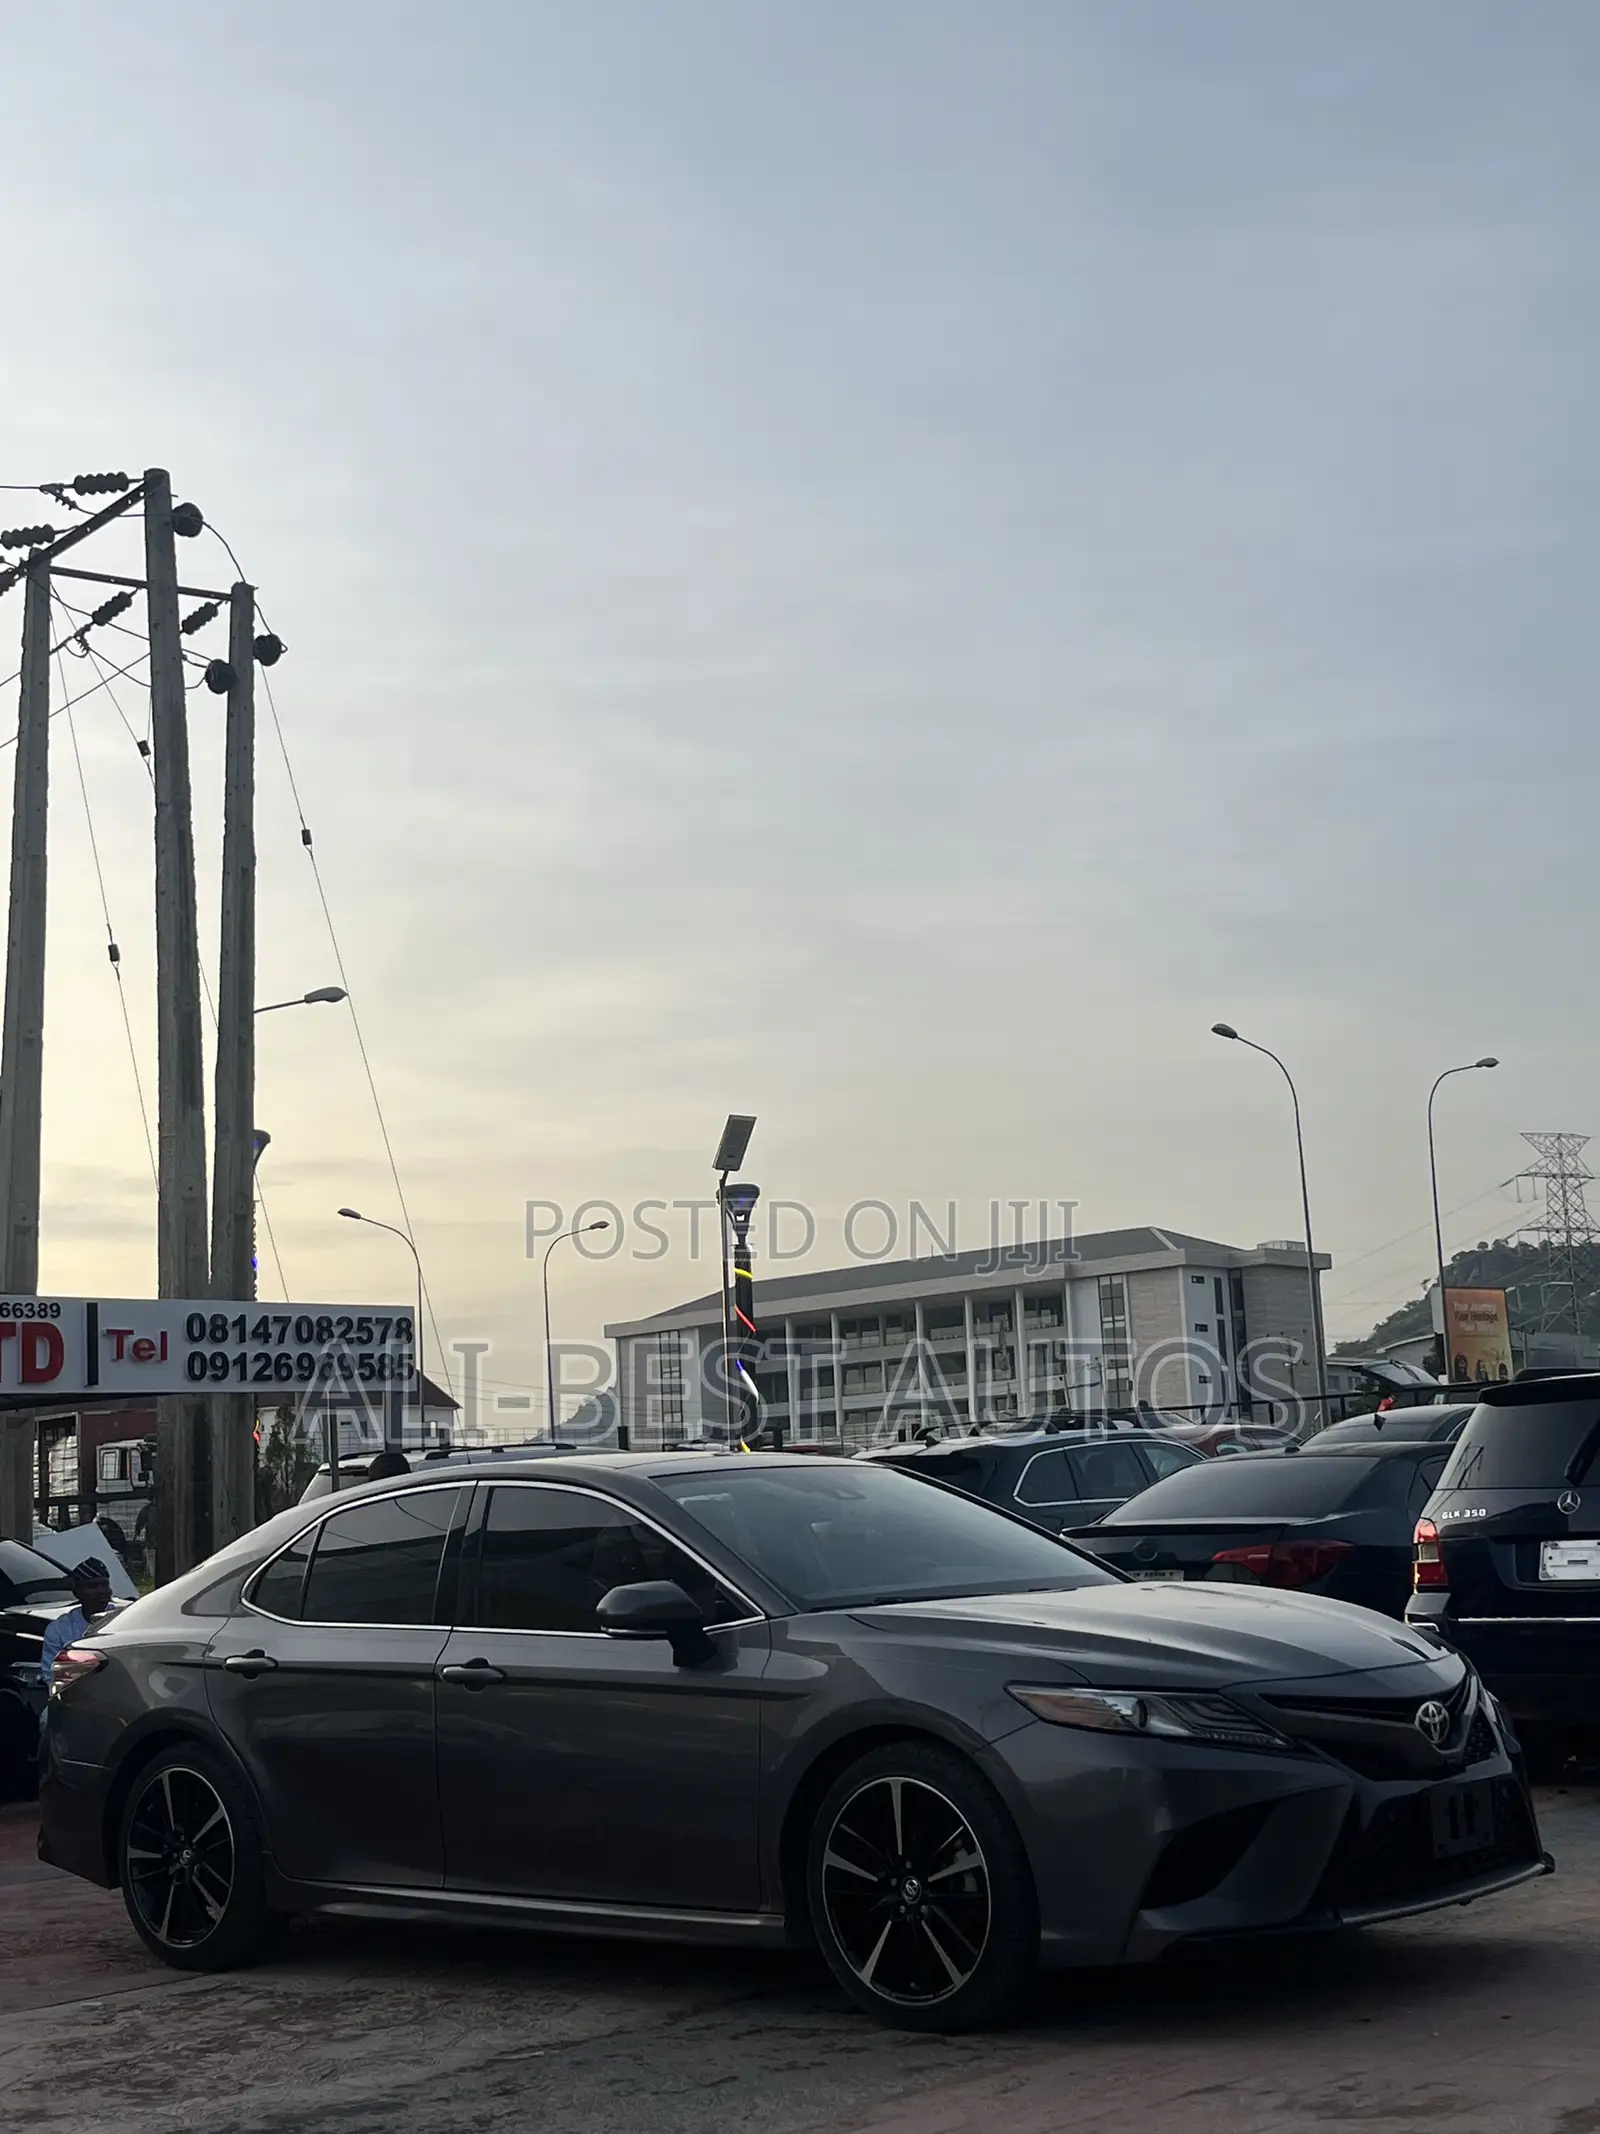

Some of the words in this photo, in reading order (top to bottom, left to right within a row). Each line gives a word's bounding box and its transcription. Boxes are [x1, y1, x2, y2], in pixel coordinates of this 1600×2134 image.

[103, 1328, 168, 1361] Tel
[186, 1312, 413, 1345] 08147082578
[187, 1351, 415, 1382] 09126969585
[1441, 1510, 1460, 1519] GLK
[1463, 1508, 1486, 1518] 350
